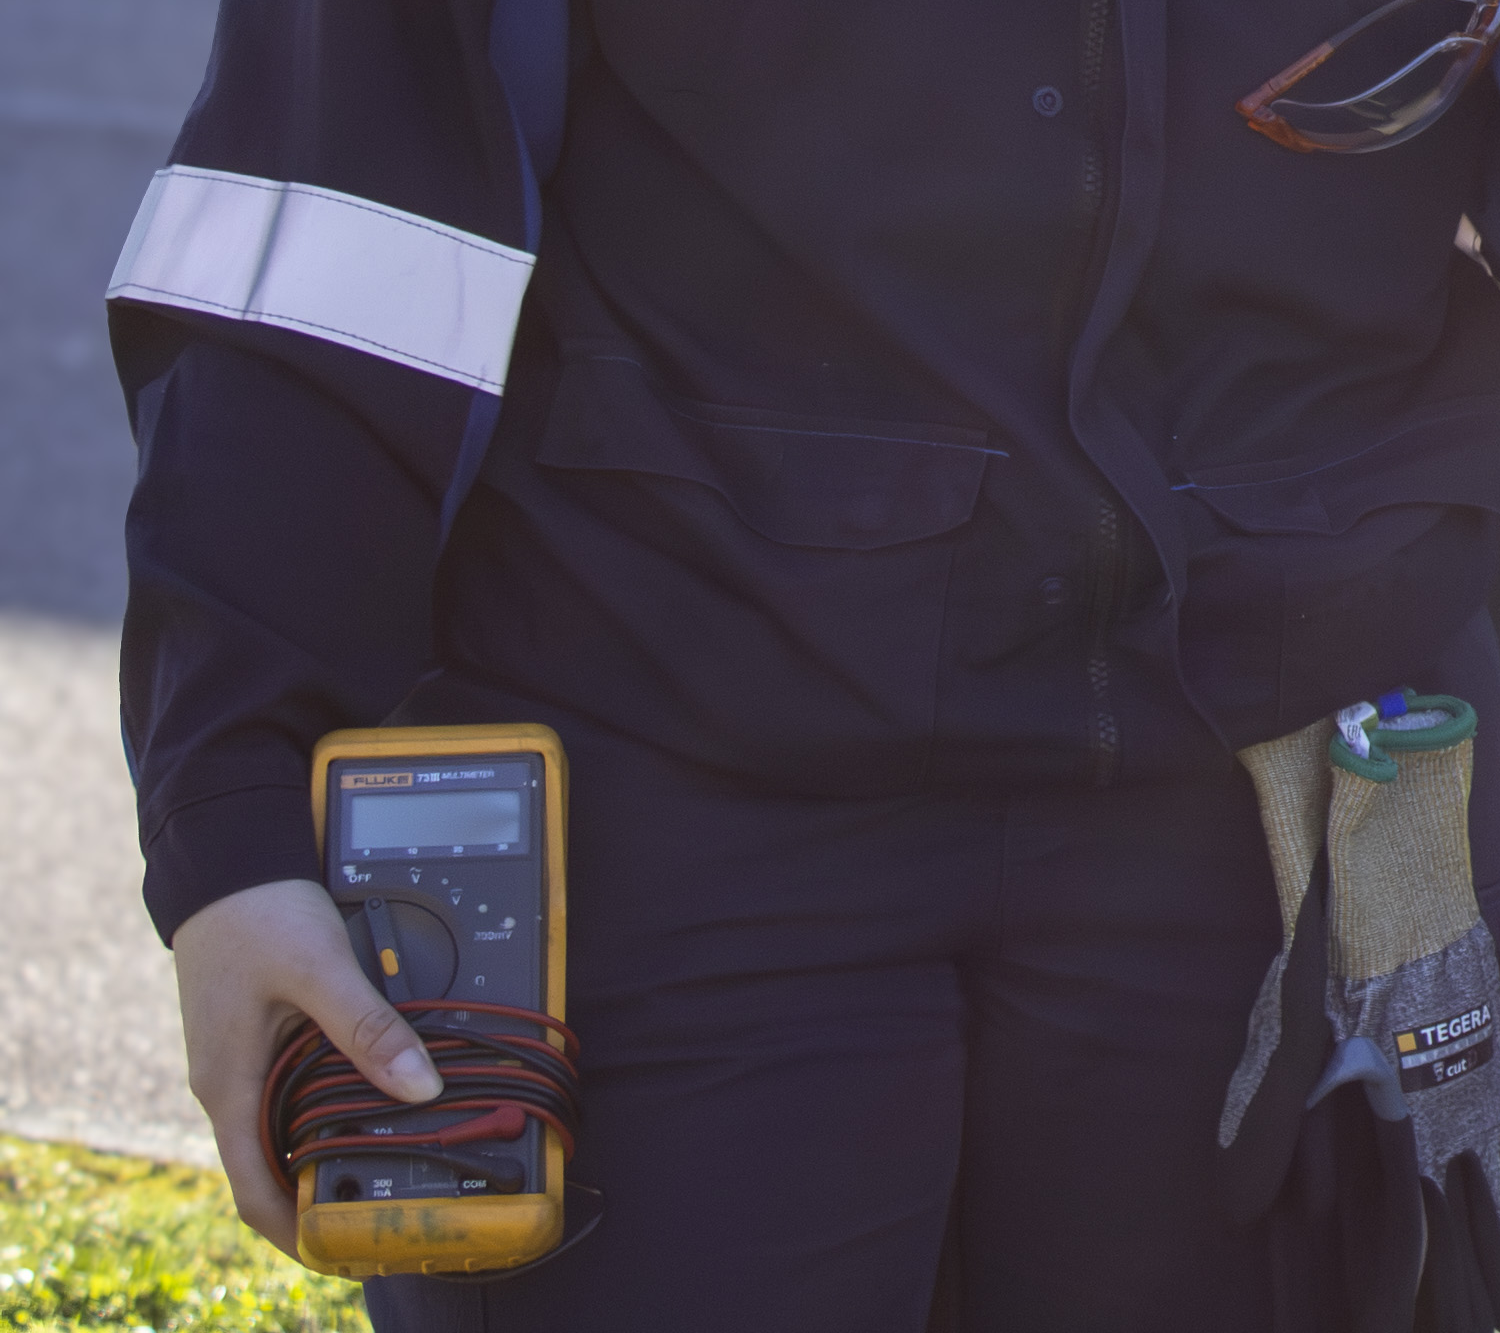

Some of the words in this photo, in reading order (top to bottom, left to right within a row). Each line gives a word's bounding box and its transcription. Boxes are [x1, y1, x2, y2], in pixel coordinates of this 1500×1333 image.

[353, 774, 409, 786] FLUKE
[441, 769, 495, 780] MULTIMETER
[349, 873, 372, 884] OFF
[1420, 1005, 1492, 1046] TEGERA
[1446, 1058, 1468, 1077] cut
[463, 1179, 487, 1189] COM
